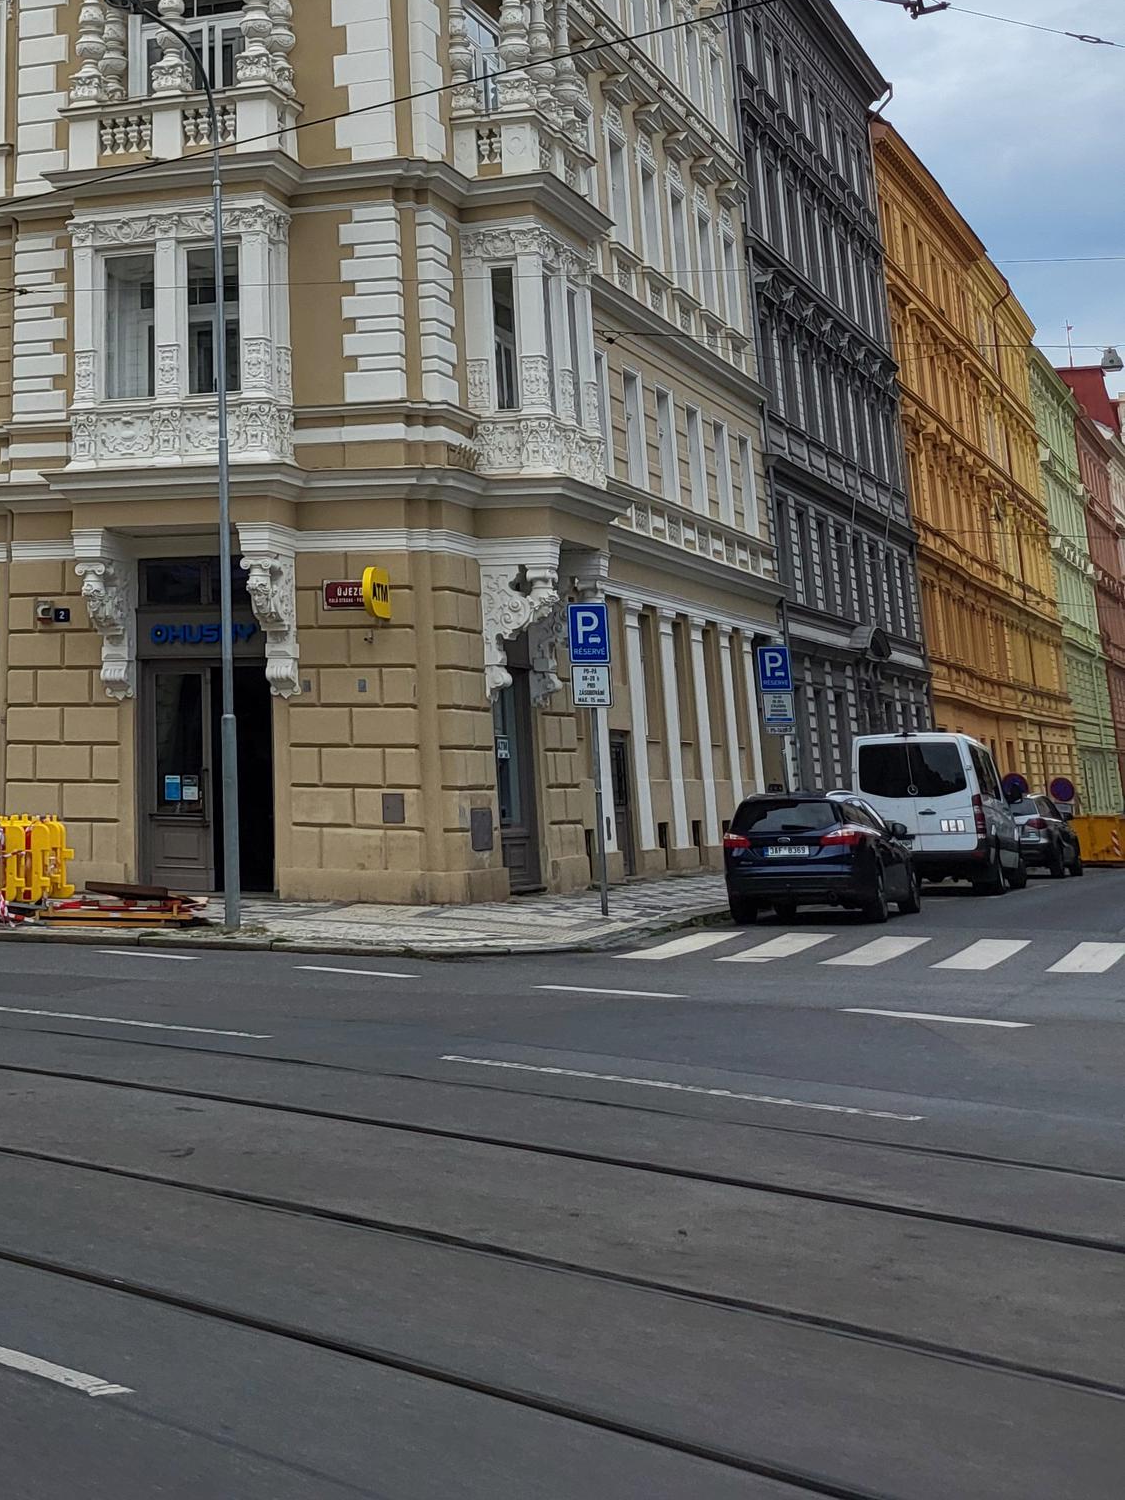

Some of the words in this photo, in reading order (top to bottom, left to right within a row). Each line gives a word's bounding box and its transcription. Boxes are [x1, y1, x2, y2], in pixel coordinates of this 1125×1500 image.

[372, 581, 389, 603] ATM
[59, 610, 65, 620] 2
[169, 623, 256, 644] HUSY
[576, 611, 599, 644] P
[574, 647, 606, 656] RÉSERVÉ
[764, 651, 783, 677] P
